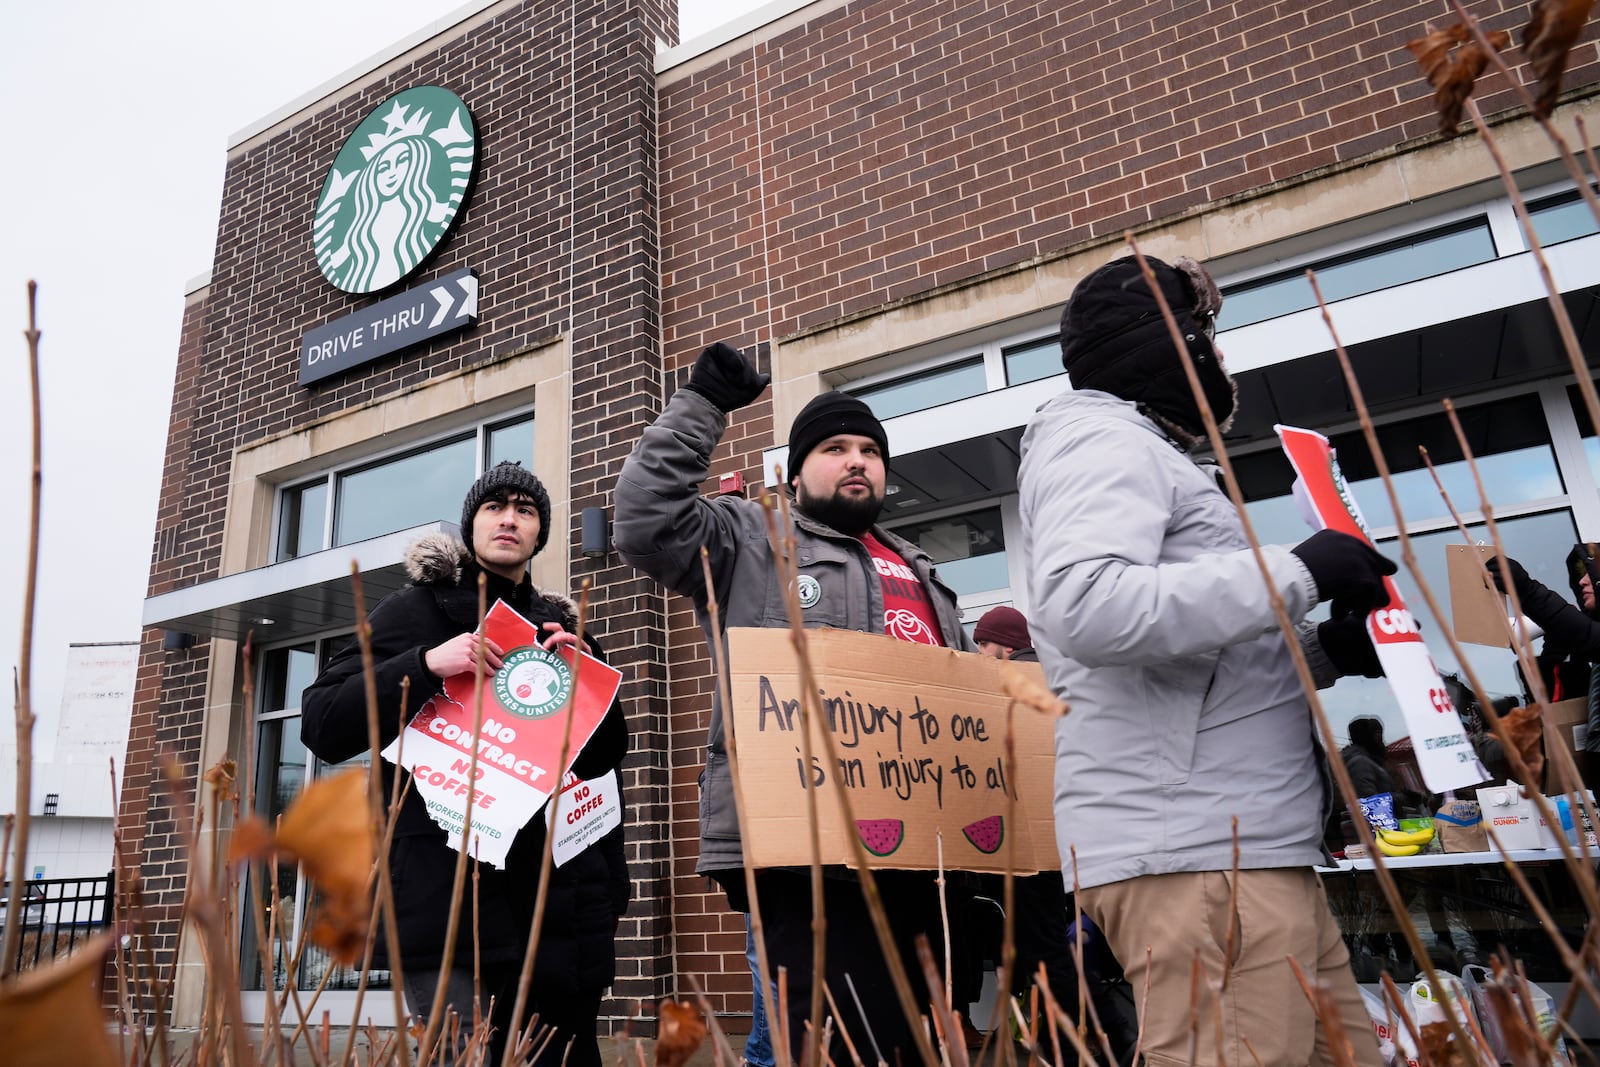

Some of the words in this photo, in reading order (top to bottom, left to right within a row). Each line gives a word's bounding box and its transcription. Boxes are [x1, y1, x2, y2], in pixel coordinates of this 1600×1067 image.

[307, 327, 364, 366] DRIVE
[370, 303, 425, 341] THRU
[516, 651, 571, 685] STARBUCKS
[496, 661, 520, 713] WORKERS
[526, 692, 568, 716] UNITED
[759, 675, 801, 732] An
[818, 688, 903, 753] injury
[909, 695, 940, 744] to
[951, 713, 989, 742] one
[481, 718, 516, 744] NO
[429, 717, 547, 783] CONTRACT
[450, 758, 485, 782] NO
[795, 746, 826, 789] is
[877, 750, 943, 810] injury
[950, 754, 976, 790] to
[414, 765, 497, 810] COFFEE
[574, 786, 590, 803] NO
[566, 794, 604, 825] COFFEE
[470, 820, 502, 840] UNITED
[558, 829, 583, 848] STARBUCKS
